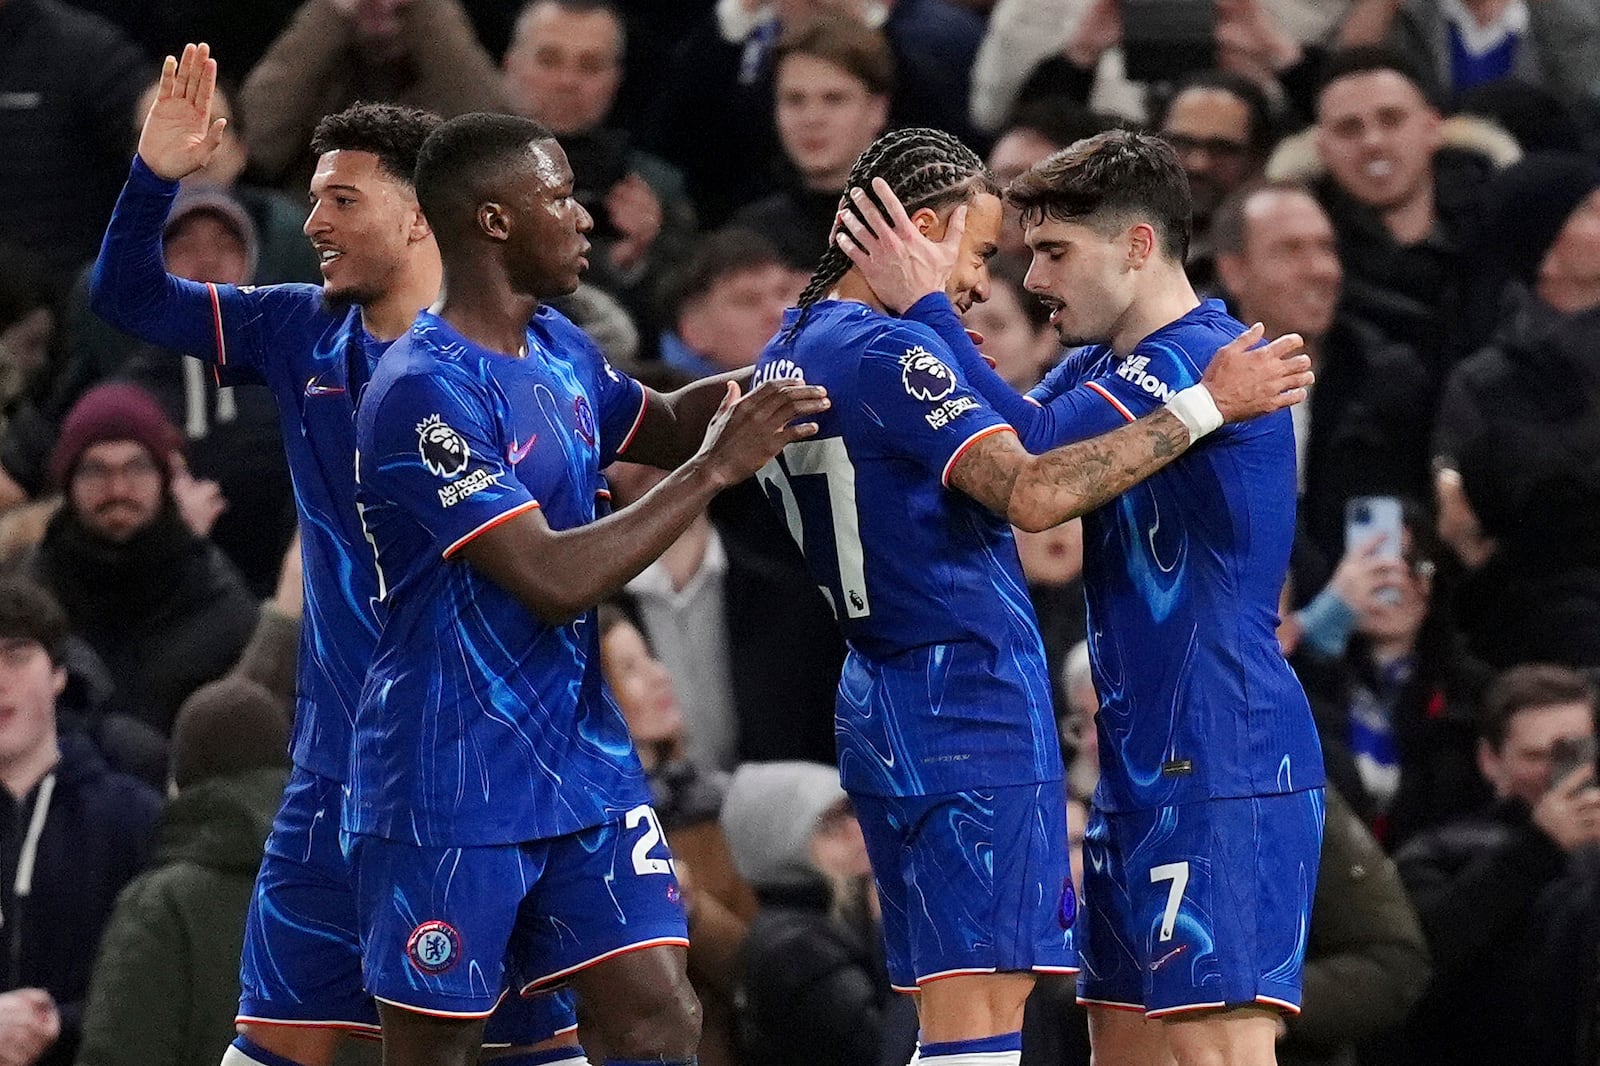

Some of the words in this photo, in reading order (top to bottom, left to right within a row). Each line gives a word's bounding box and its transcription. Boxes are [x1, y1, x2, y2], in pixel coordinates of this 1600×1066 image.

[925, 407, 945, 420] No
[437, 485, 456, 498] No
[453, 468, 487, 490] room
[458, 475, 497, 499] racism
[441, 493, 458, 508] for
[625, 804, 678, 876] 2
[1149, 861, 1190, 941] 7
